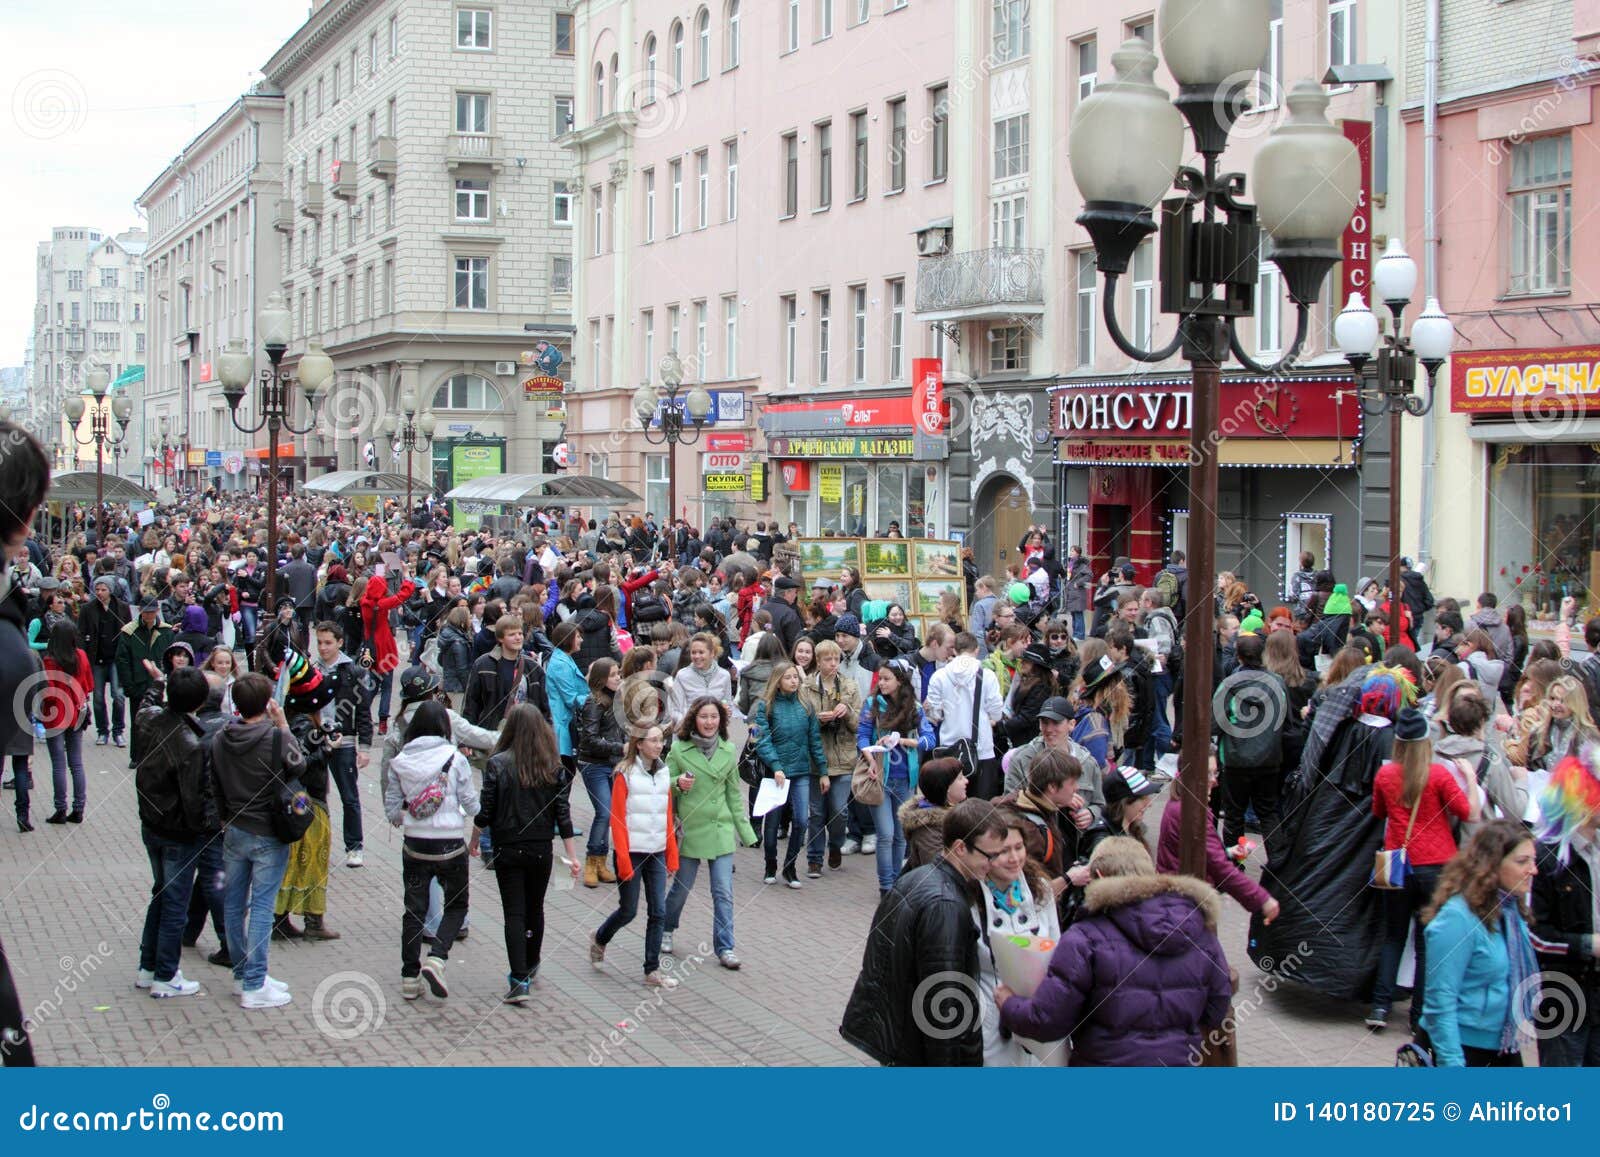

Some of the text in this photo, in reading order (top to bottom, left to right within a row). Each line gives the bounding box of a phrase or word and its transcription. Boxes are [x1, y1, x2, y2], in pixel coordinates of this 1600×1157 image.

[1058, 392, 1192, 430] КОНСУЛ
[788, 438, 854, 455] АРМЕЙСКИЙ
[709, 455, 740, 466] OTTO
[707, 475, 744, 483] СКУПКА
